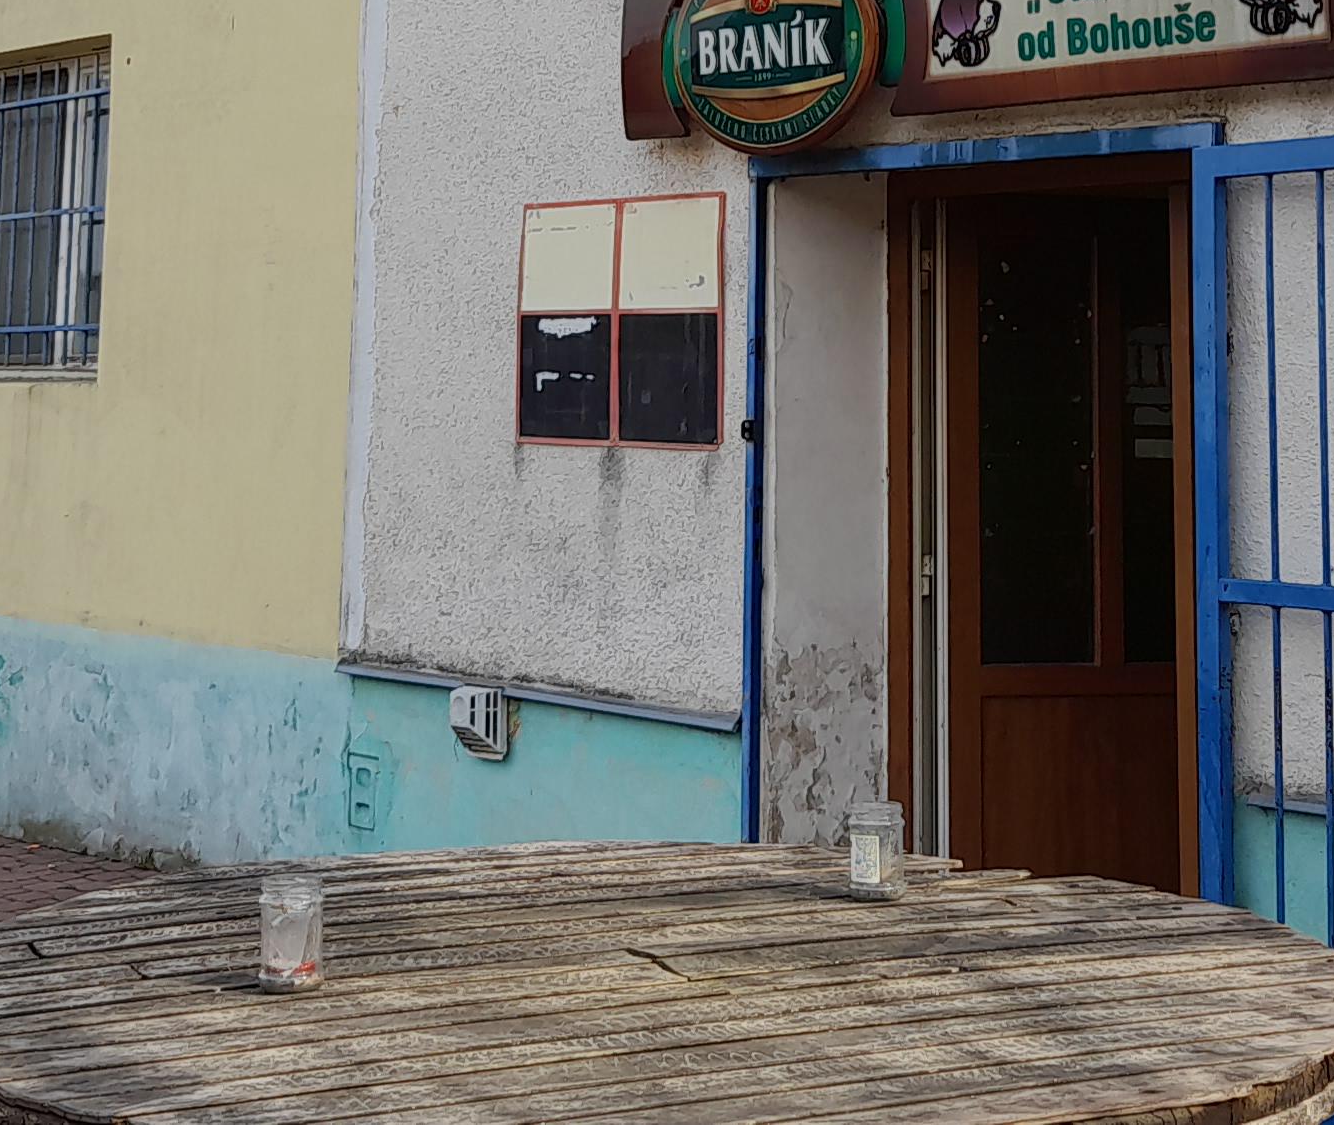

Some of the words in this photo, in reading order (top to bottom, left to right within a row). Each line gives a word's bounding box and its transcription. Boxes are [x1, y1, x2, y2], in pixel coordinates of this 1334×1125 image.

[698, 9, 834, 76] BRANÍK
[1017, 17, 1055, 62] od
[1067, 3, 1216, 57] Bohouše
[754, 71, 772, 82] 1899
